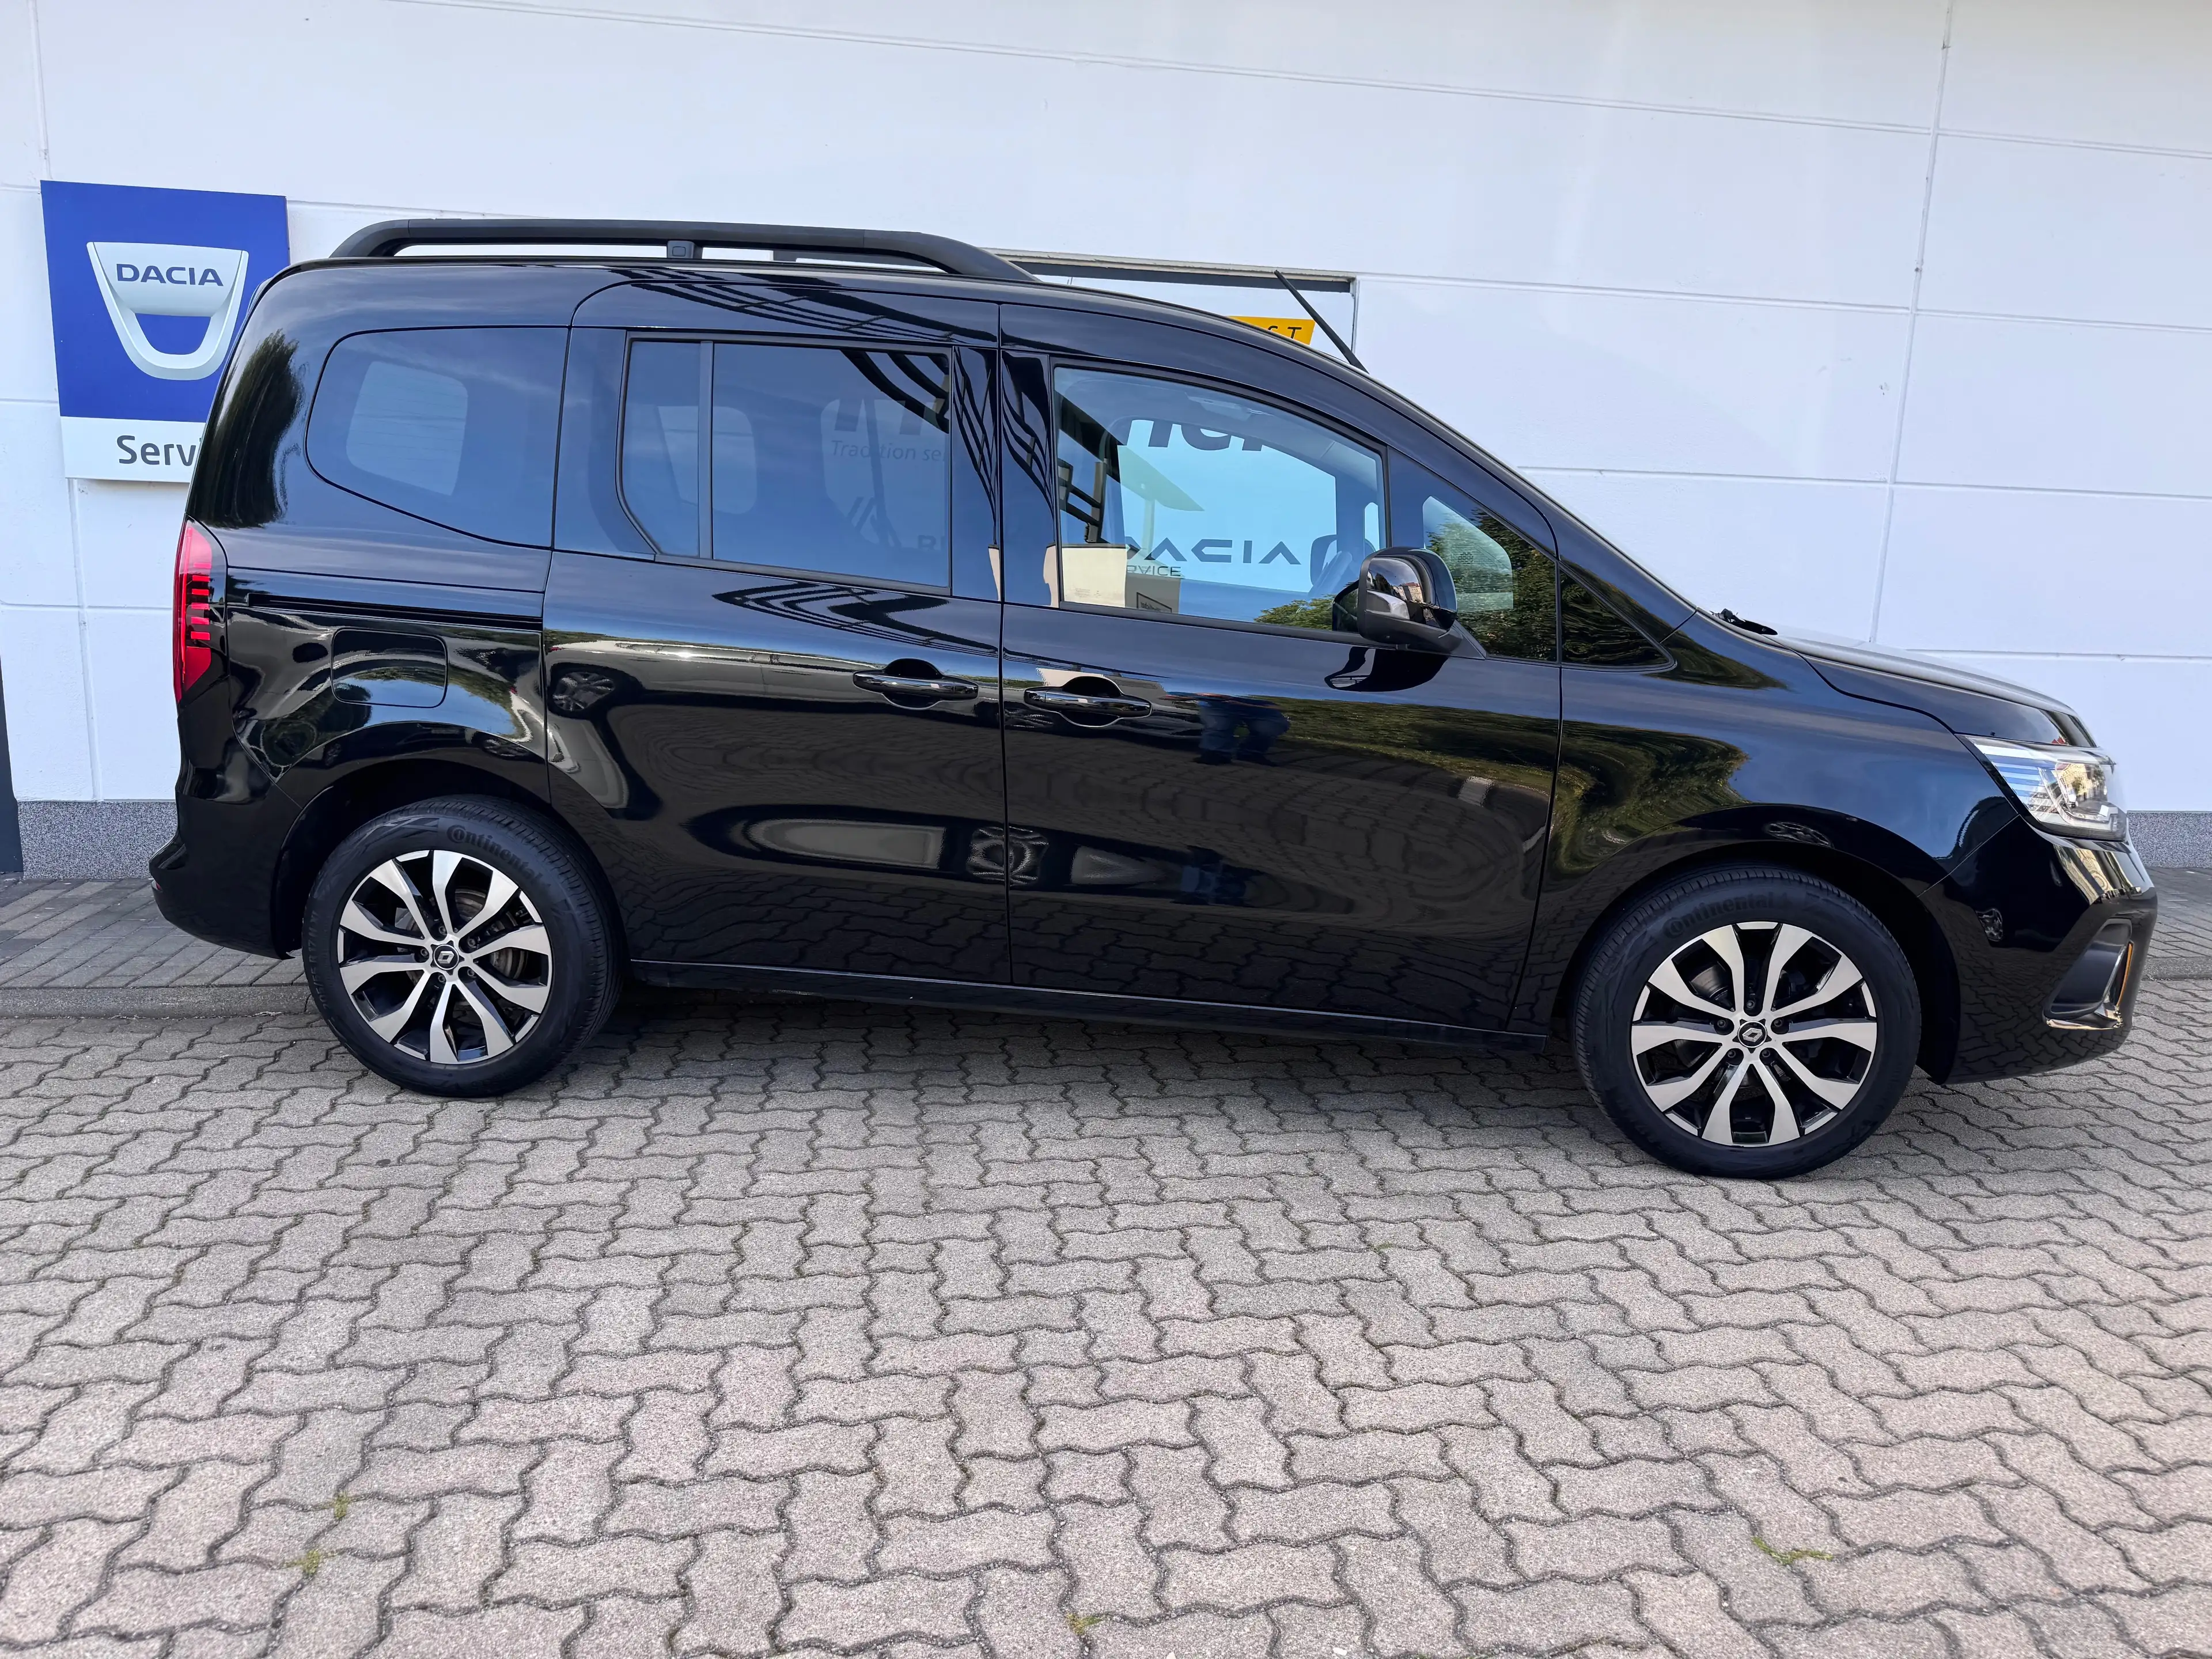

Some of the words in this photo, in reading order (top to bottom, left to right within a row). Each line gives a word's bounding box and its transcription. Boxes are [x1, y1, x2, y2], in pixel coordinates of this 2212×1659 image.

[116, 263, 224, 287] DACIA
[116, 435, 202, 467] Serv
[831, 440, 916, 460] Tration
[1127, 565, 1181, 577] RVICE
[446, 824, 543, 884] Continental
[1663, 891, 1774, 939] Continental
